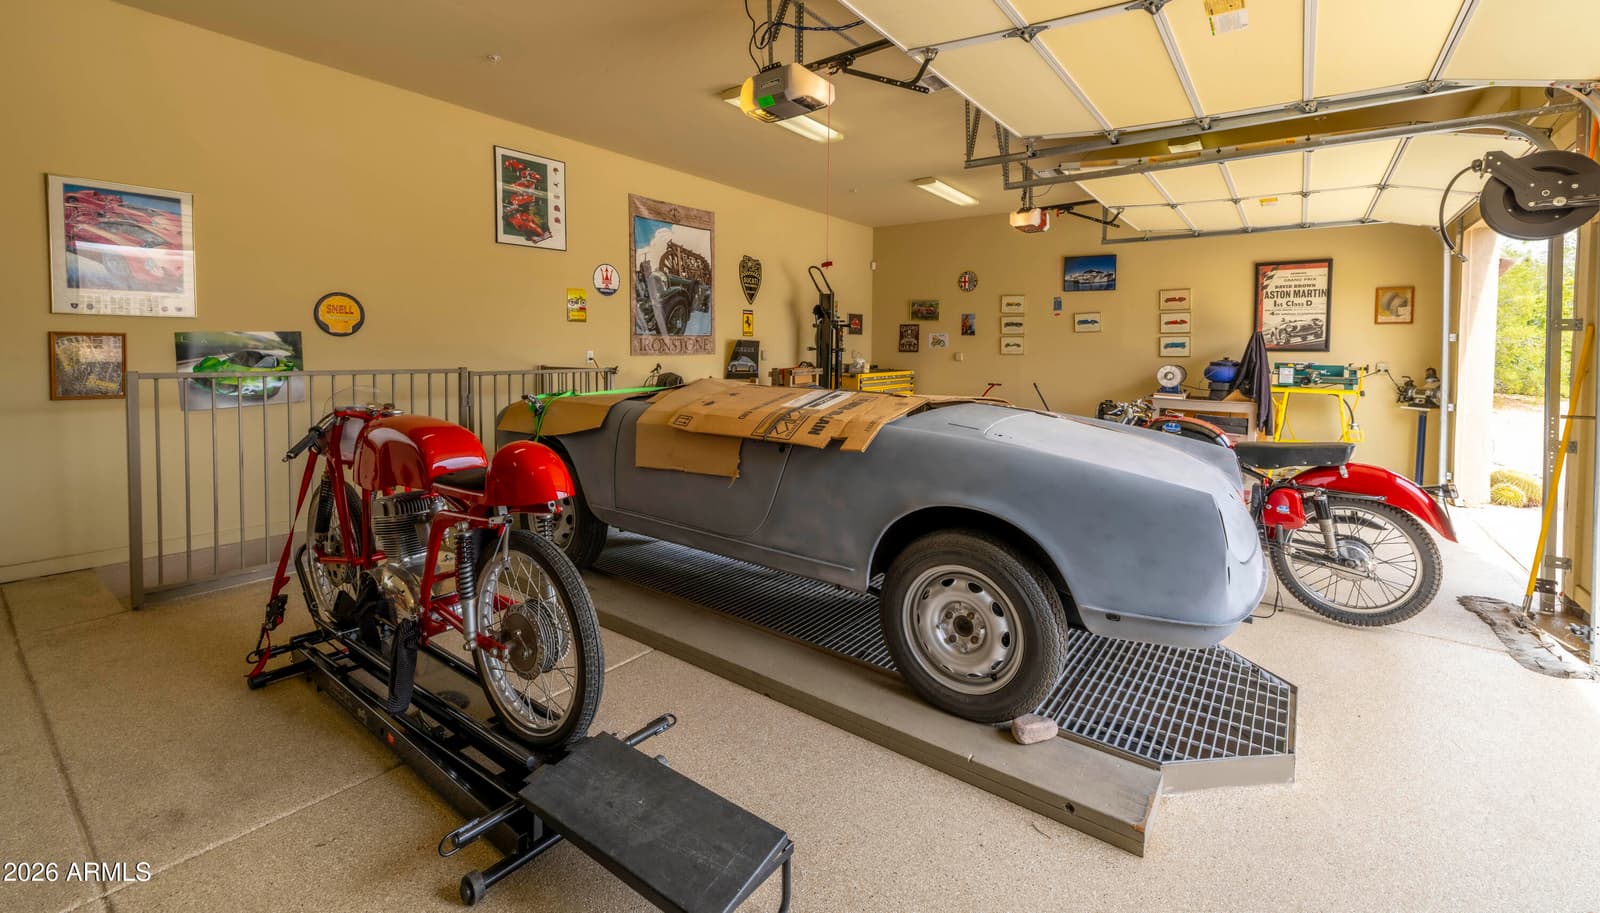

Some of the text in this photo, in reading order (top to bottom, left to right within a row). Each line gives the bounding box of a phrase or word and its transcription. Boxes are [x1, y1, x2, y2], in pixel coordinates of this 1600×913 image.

[1264, 288, 1328, 299] ASTON MARTIN
[1285, 299, 1304, 307] Class
[326, 304, 354, 314] SHELL
[639, 337, 710, 352] IRONSTONE
